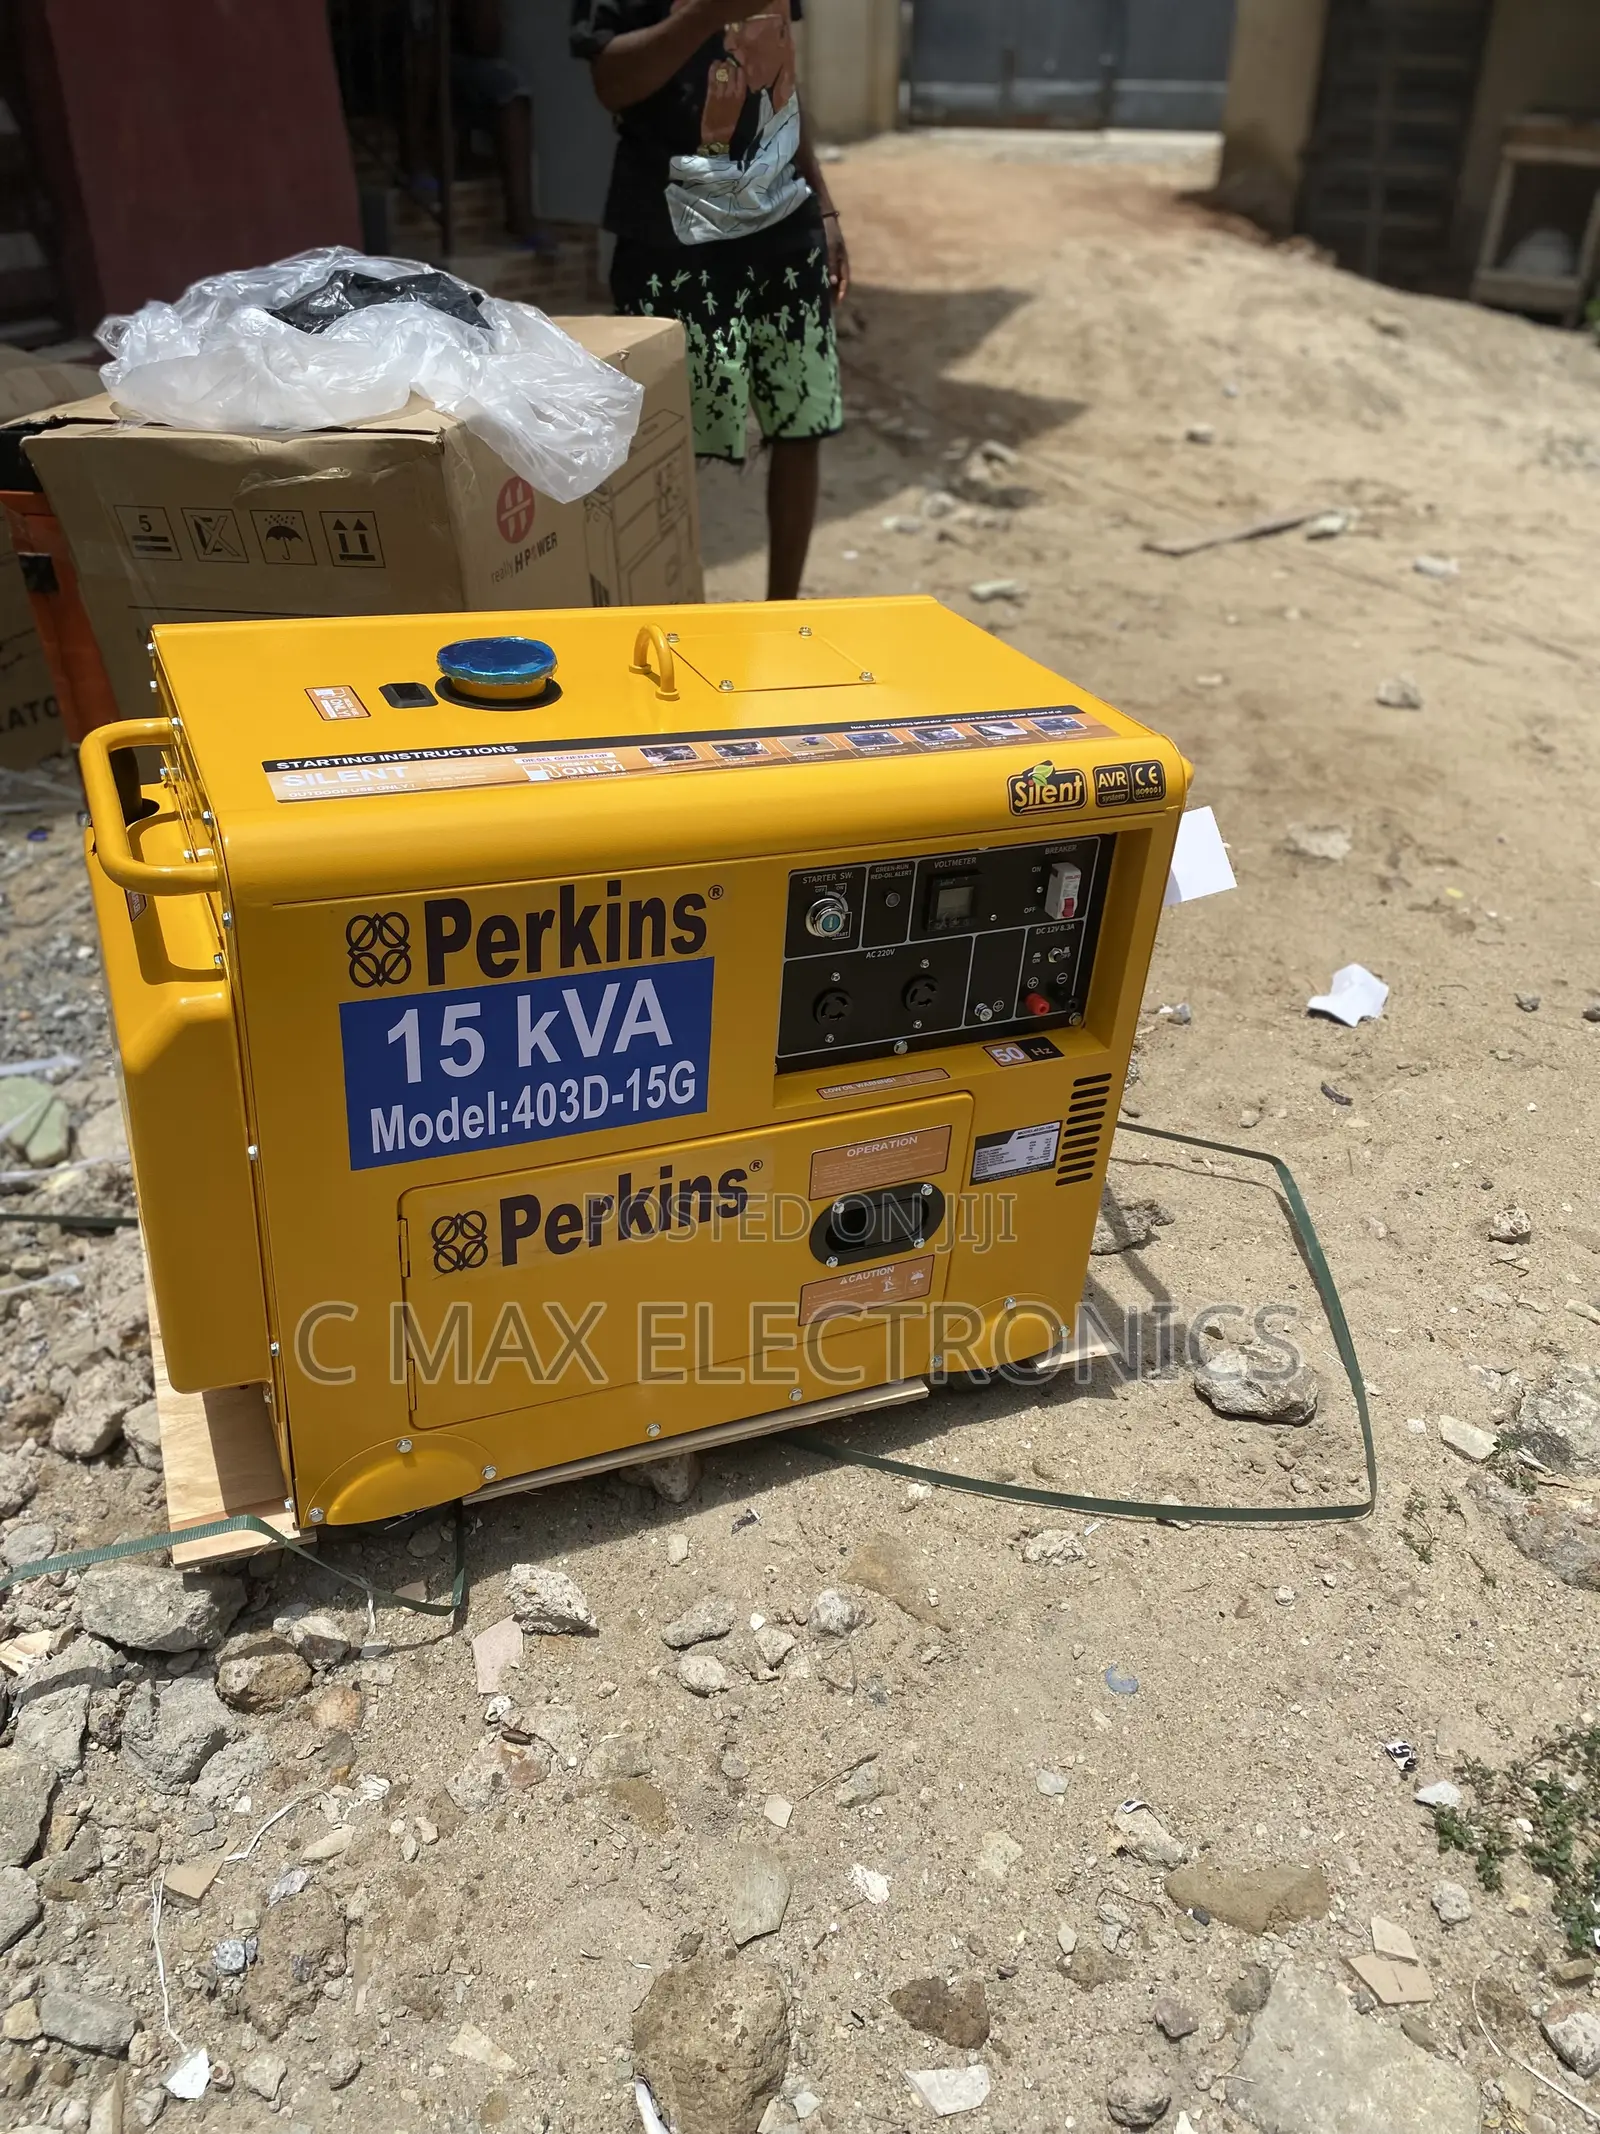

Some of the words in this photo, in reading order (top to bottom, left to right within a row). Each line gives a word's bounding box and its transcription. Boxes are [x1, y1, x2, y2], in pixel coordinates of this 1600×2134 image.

[138, 514, 152, 533] 5
[0, 695, 61, 734] ATO
[276, 754, 376, 770] STARTING
[379, 745, 519, 762] INSTRUCTIONS
[554, 753, 608, 761] GENERATOR
[281, 765, 410, 788] SILENT
[562, 763, 627, 775] ONLY!
[1098, 771, 1127, 788] AVR
[288, 787, 348, 798] OUTDOOR
[349, 785, 375, 793] USE
[375, 783, 409, 792] ONLY
[1014, 775, 1083, 808] Silent
[1101, 793, 1126, 802] system
[1045, 844, 1078, 855] BREAKER
[875, 863, 909, 873] GREEN-RUN
[934, 857, 977, 869] VOLTMETER
[803, 873, 837, 884] STARTER
[840, 872, 854, 881] SW.
[1024, 906, 1037, 914] OFF
[1036, 927, 1046, 935] DC
[1047, 925, 1060, 933] 12V
[1060, 923, 1076, 931] 8.3A
[866, 950, 877, 959] AC
[877, 948, 896, 957] 220V
[387, 1001, 486, 1084] 15
[516, 978, 673, 1068] kVA
[991, 1046, 1025, 1064] 50
[1030, 1046, 1053, 1057] Hz
[822, 1086, 842, 1094] LOW
[856, 1077, 897, 1089] WARNING!
[370, 1060, 696, 1154] Model:403D-15G
[846, 1136, 918, 1158] OPERATION
[848, 1265, 895, 1283] CAUTION
